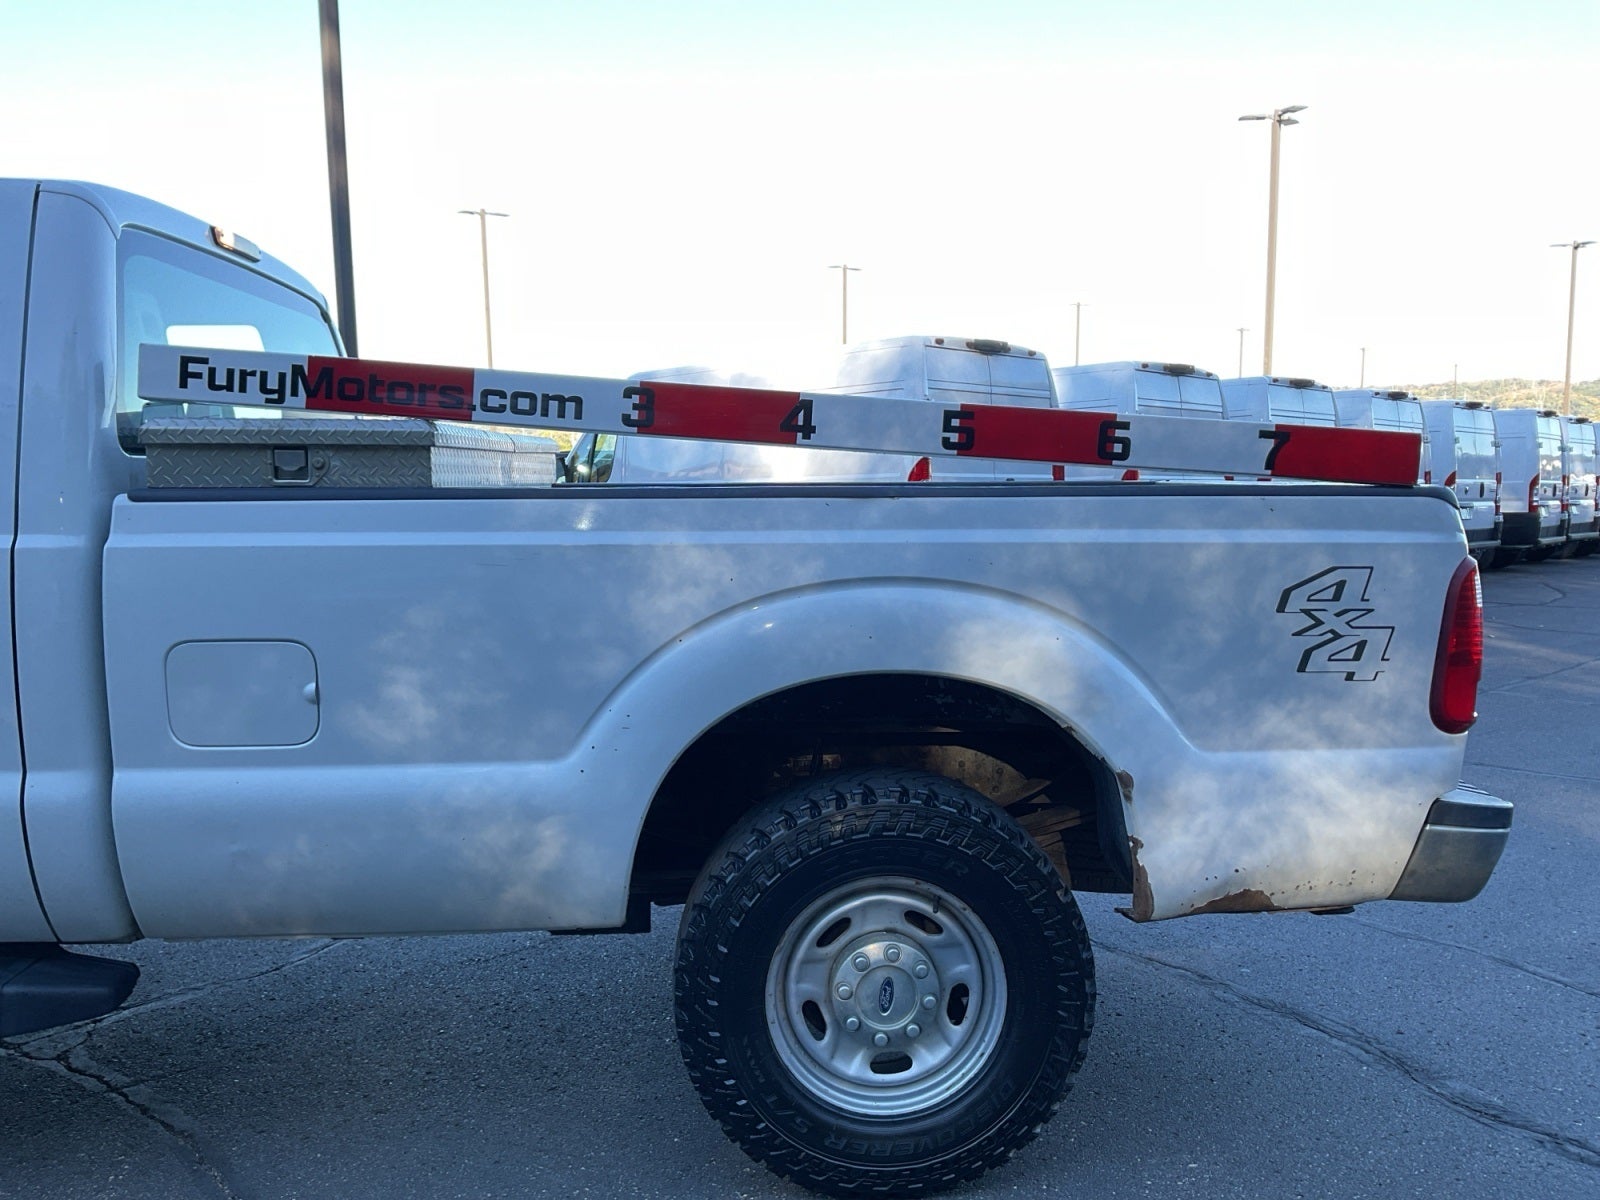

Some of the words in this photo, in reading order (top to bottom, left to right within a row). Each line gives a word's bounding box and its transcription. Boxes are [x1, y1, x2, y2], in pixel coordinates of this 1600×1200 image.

[178, 354, 584, 420] FuryMotors.com
[620, 386, 655, 428] 3
[779, 399, 817, 440] 4
[941, 410, 975, 451] 5
[1097, 421, 1131, 461] 6
[1258, 430, 1291, 470] 7
